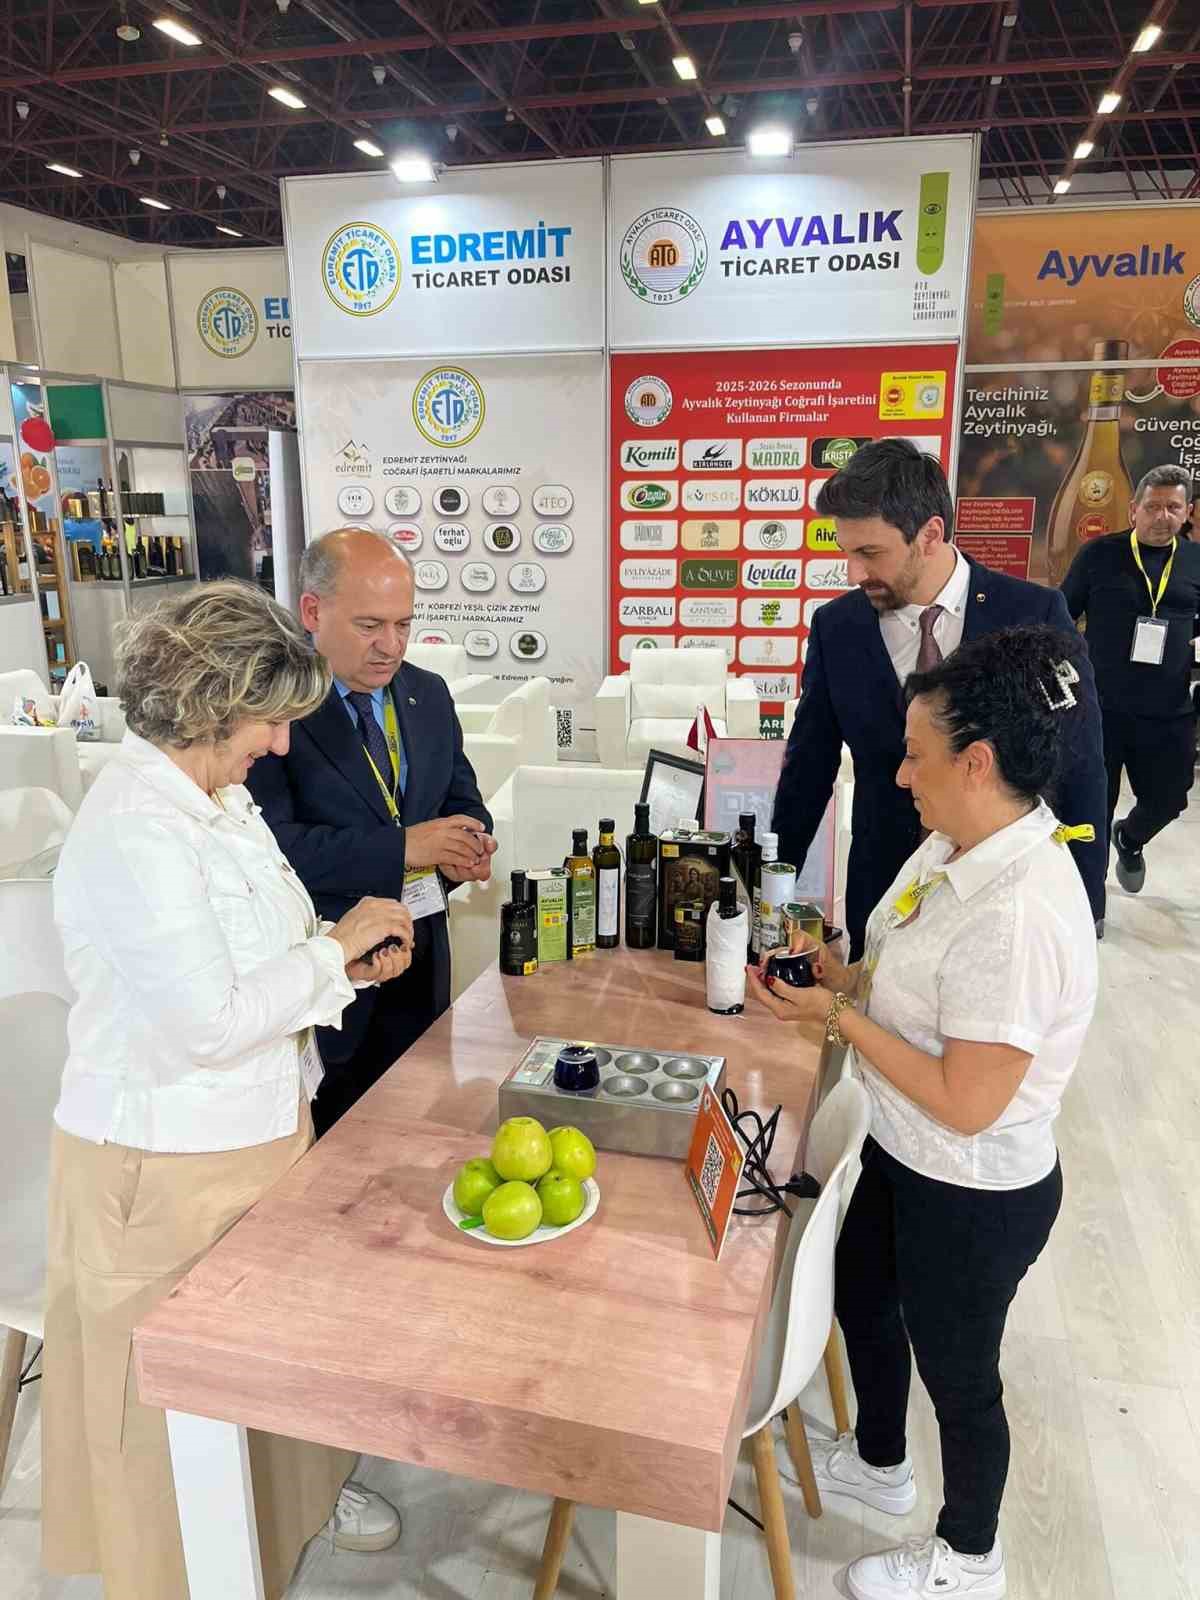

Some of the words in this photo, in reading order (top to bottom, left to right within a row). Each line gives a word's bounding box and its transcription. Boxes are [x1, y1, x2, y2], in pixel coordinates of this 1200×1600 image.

[720, 209, 903, 250] AYVALIK
[411, 221, 572, 265] EDREMİT
[650, 244, 676, 266] ATO
[720, 256, 820, 277] TİCARET
[828, 252, 900, 272] ODASI
[1037, 244, 1186, 286] Ayvalık
[412, 269, 500, 289] TİCARET
[507, 266, 571, 284] ODASI
[716, 379, 778, 392] 2025-2026
[779, 378, 842, 391] Sezonunda
[682, 396, 723, 409] Ayvalık
[725, 396, 782, 411] Zeytinyağı
[784, 395, 826, 410] Coğrafi
[827, 393, 877, 408] İşaretini
[966, 388, 1048, 401] Tercihiniz
[726, 412, 777, 425] Kullanan
[779, 411, 829, 423] Firmalar
[965, 405, 1026, 418] Ayvalık
[963, 421, 1057, 437] Zeytinyağı,
[420, 454, 467, 464] ZEYTİNYAĞI
[625, 446, 677, 467] Komili
[752, 451, 800, 466] MADRA
[439, 528, 465, 536] ferhat
[747, 563, 797, 585] Lovida
[428, 602, 462, 611] KÖRFEZİ
[623, 605, 672, 615] ZARBALI
